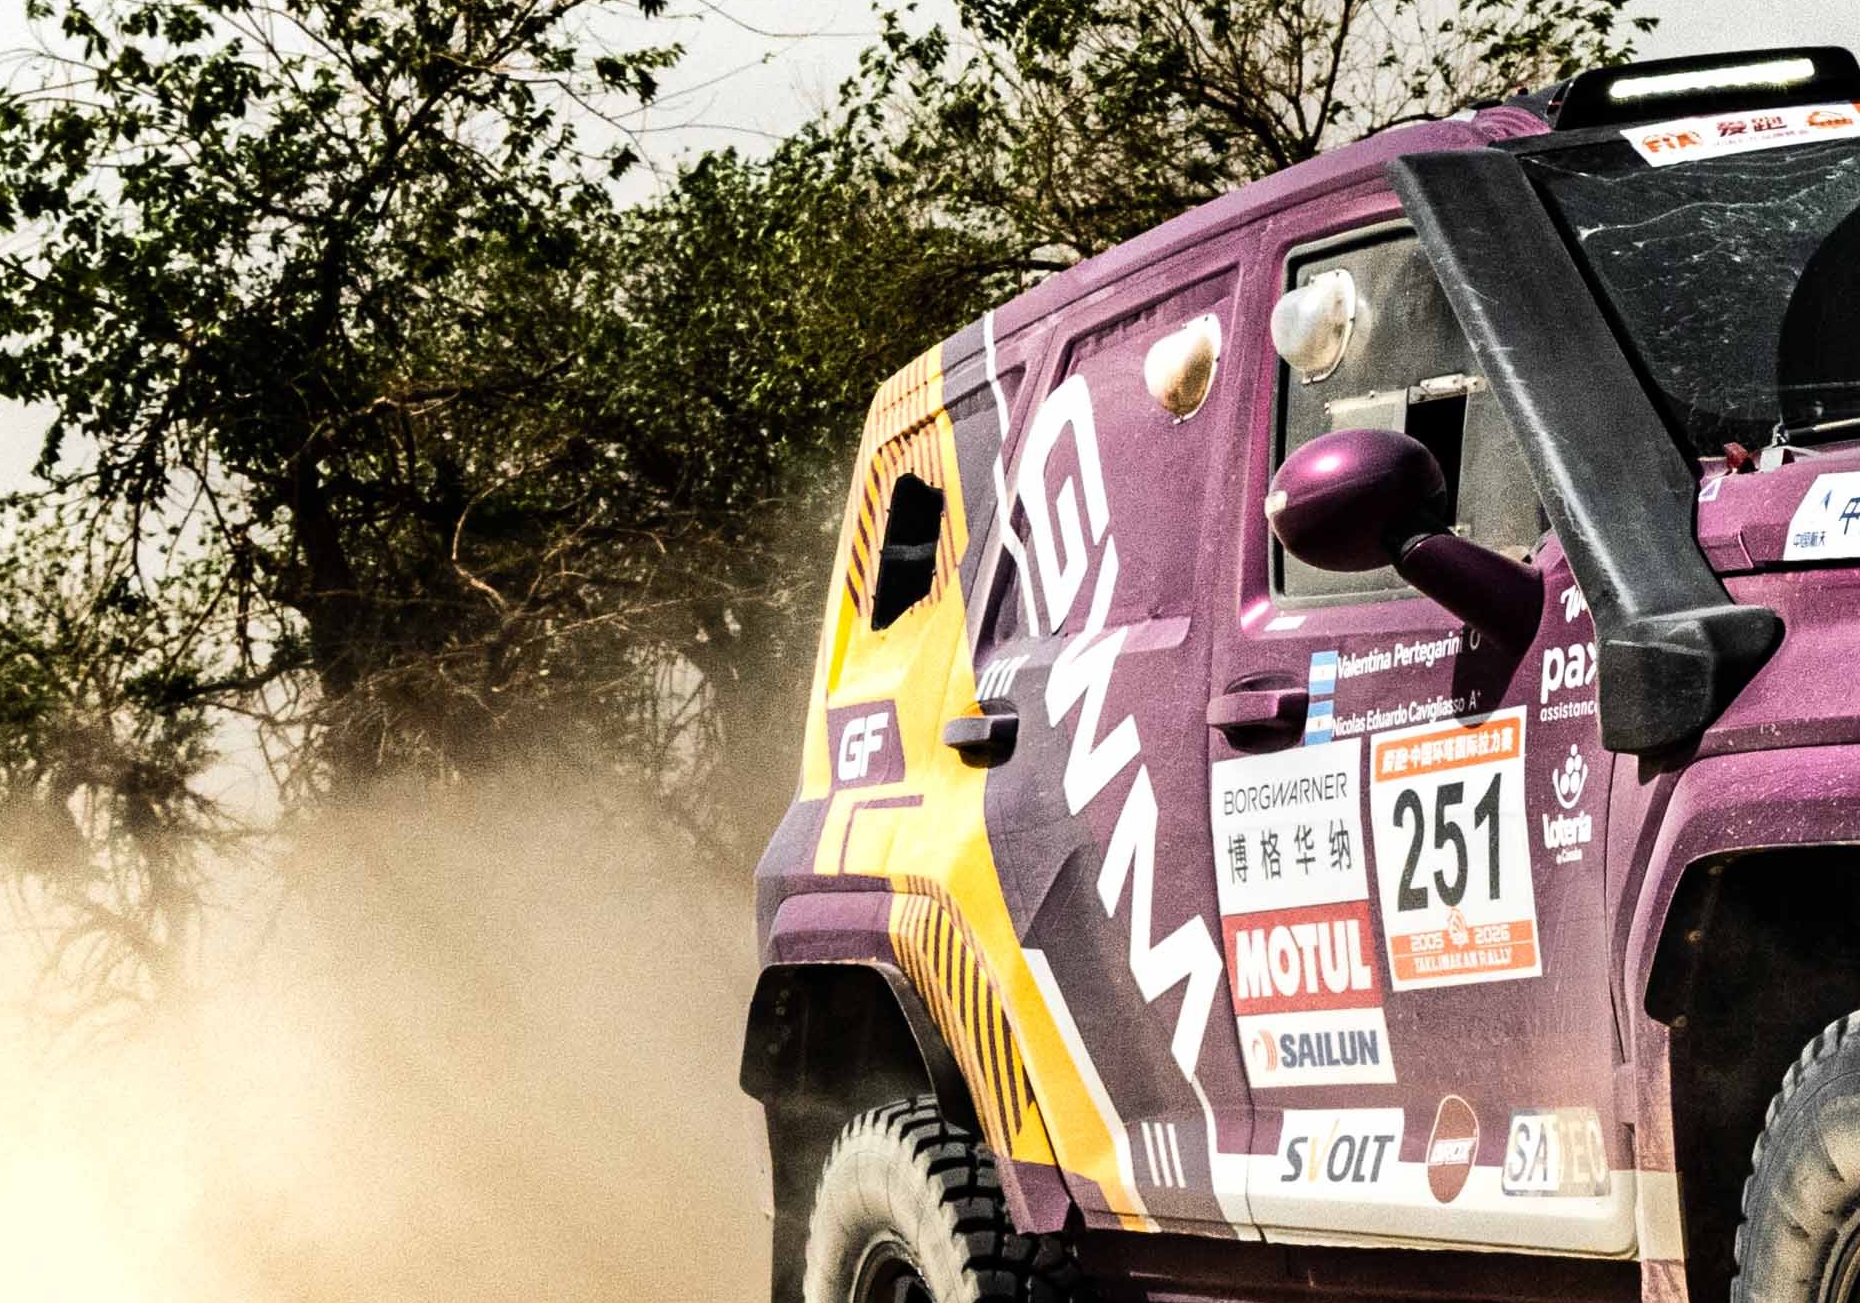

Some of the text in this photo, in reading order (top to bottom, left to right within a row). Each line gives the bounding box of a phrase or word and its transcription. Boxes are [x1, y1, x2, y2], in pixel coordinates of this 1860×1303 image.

[1337, 648, 1391, 680] Valentina
[1393, 632, 1464, 669] Pertegarini
[837, 710, 890, 781] GF
[1333, 713, 1366, 737] Nicolas
[1367, 705, 1408, 730] Eduardo
[1224, 772, 1348, 816] BORGWARNER
[1227, 819, 1353, 885] 博格华纳
[1393, 772, 1502, 912] 251
[1235, 919, 1373, 999] MOTUL
[1280, 1029, 1380, 1069] SAILUN
[1281, 1118, 1395, 1182] SVOLT
